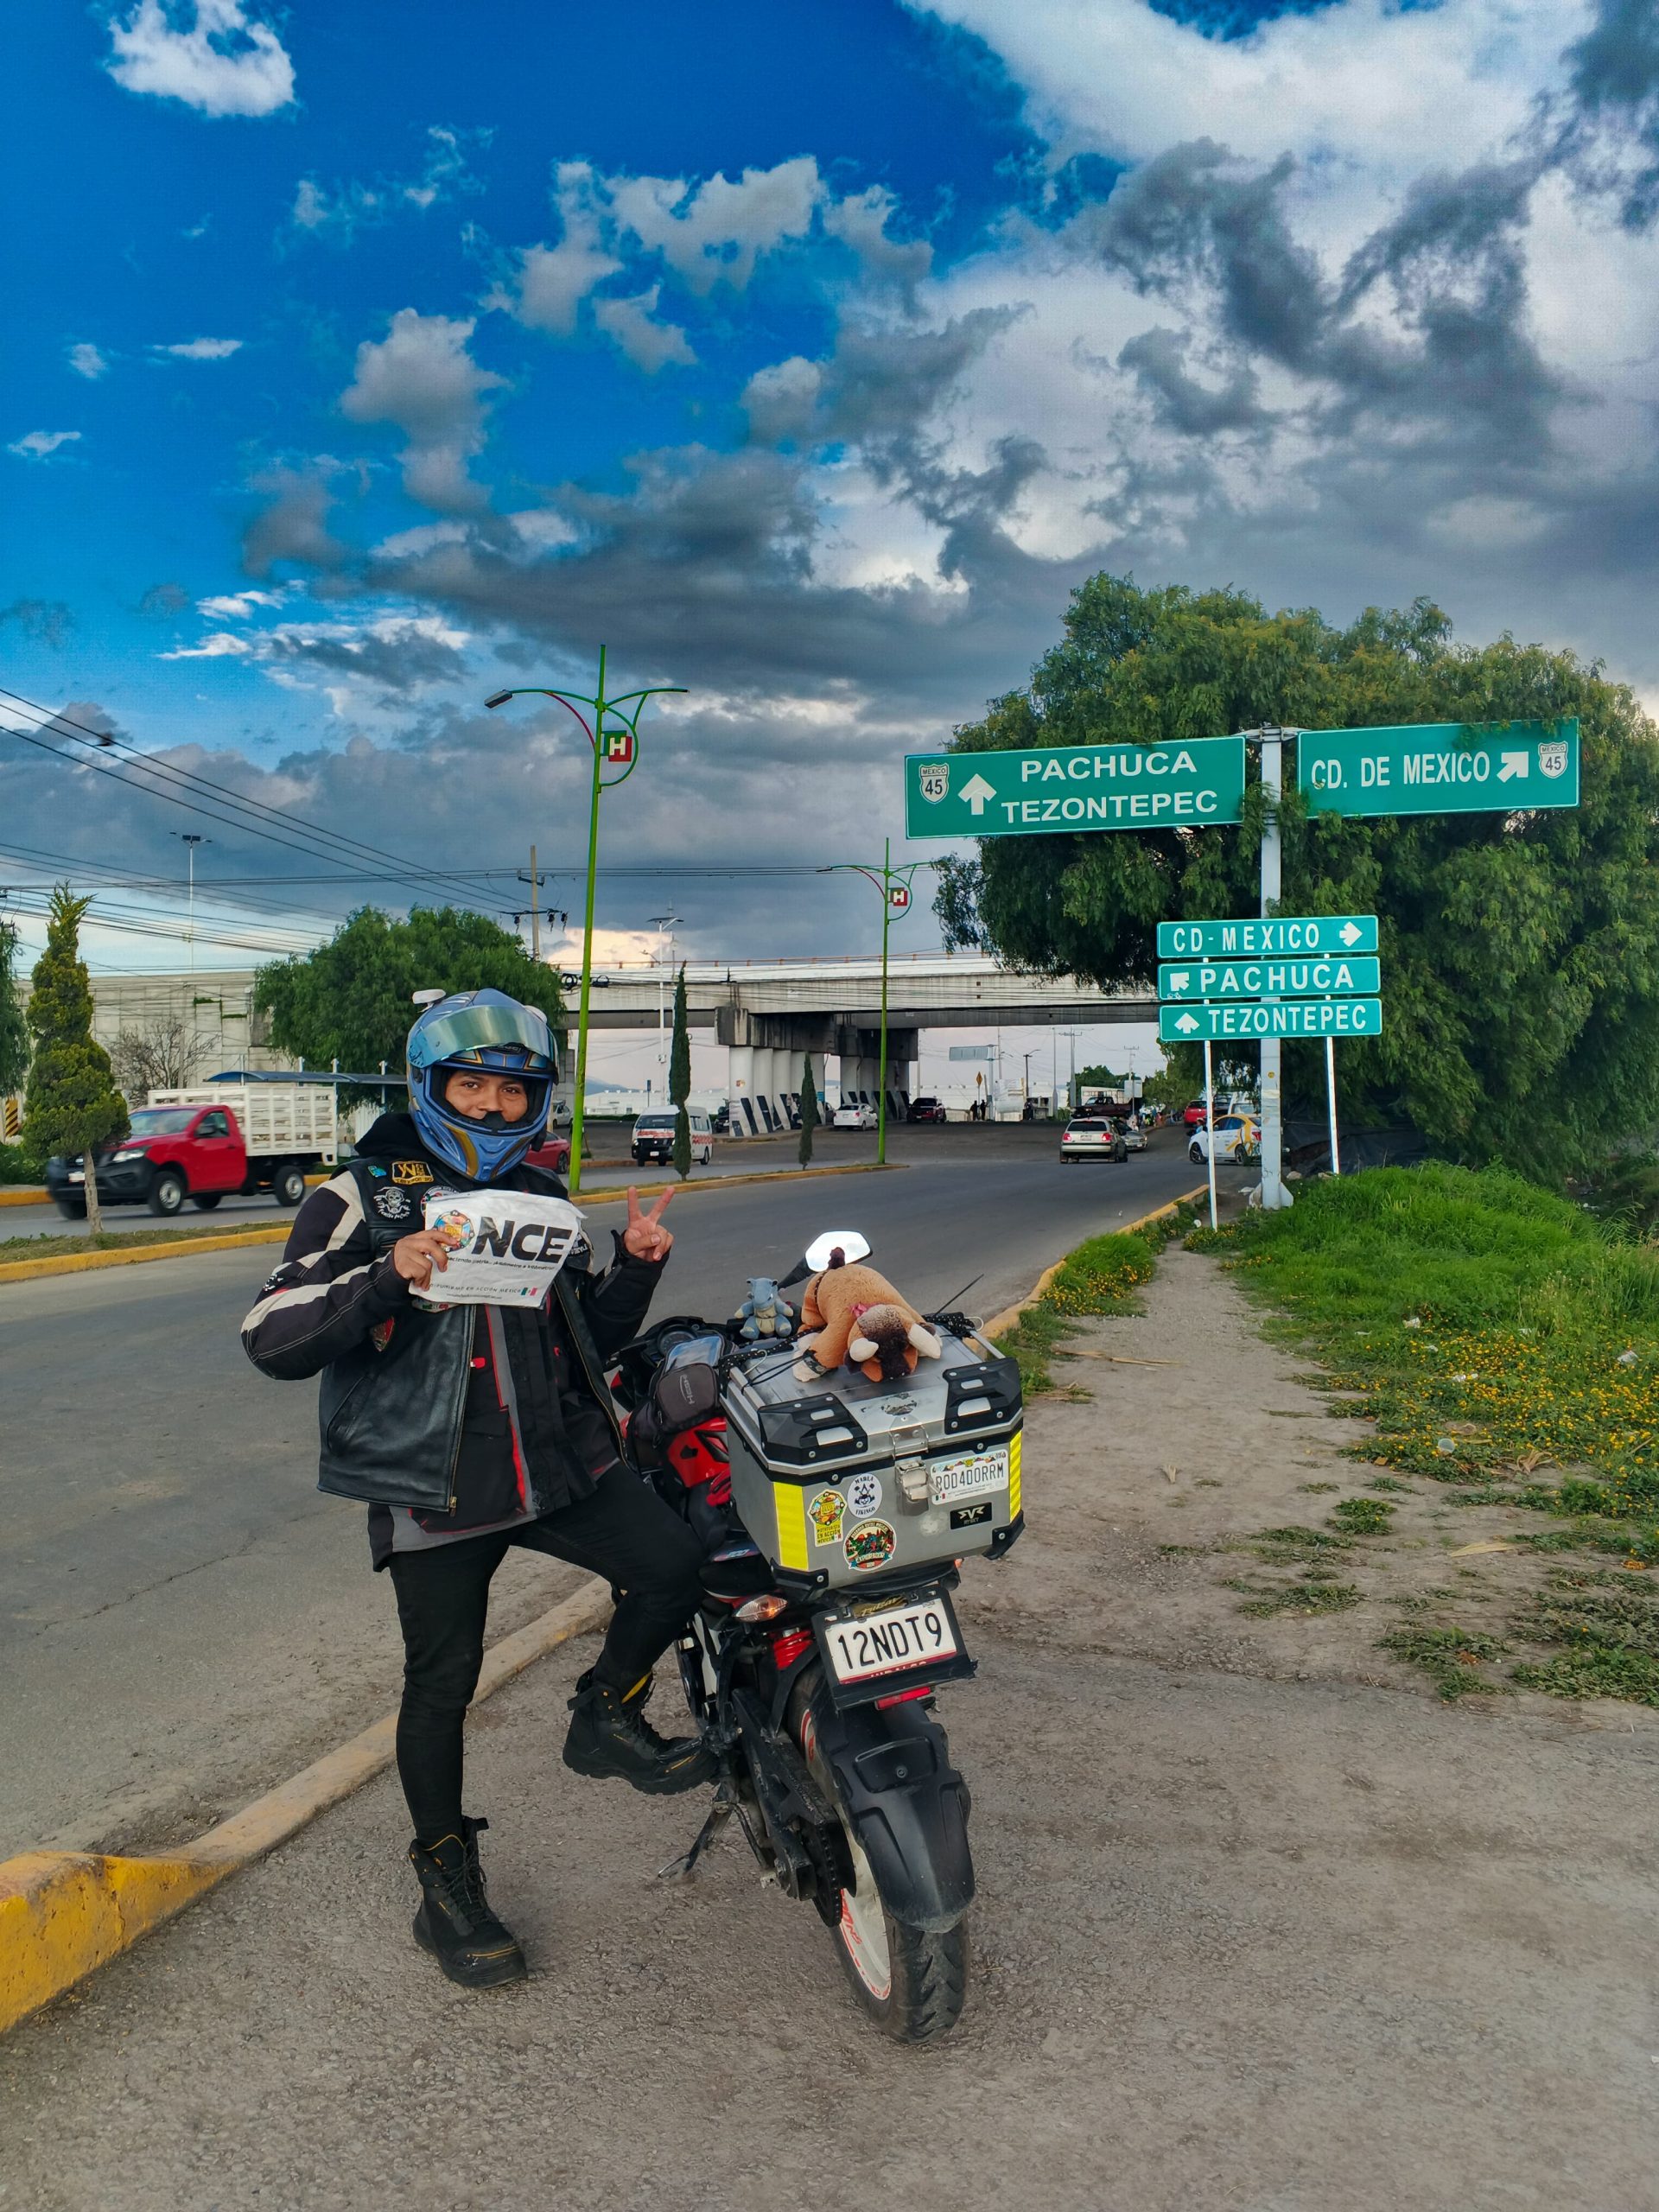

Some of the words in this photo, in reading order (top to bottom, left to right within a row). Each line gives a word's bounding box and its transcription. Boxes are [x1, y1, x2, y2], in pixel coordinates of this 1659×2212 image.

[922, 766, 948, 776] MEXICO
[1021, 750, 1198, 783] PACHUCA
[1311, 759, 1348, 790] CD.
[1361, 756, 1390, 787] DE
[1403, 751, 1491, 785] MEXICO
[1545, 755, 1562, 772] 45
[925, 779, 944, 796] 45
[1001, 790, 1217, 823] TEZONTEPEC
[1200, 963, 1354, 993] PACHUCA
[1208, 1004, 1366, 1033] TEZONTEPEC
[837, 1612, 943, 1670] 12NDT9
